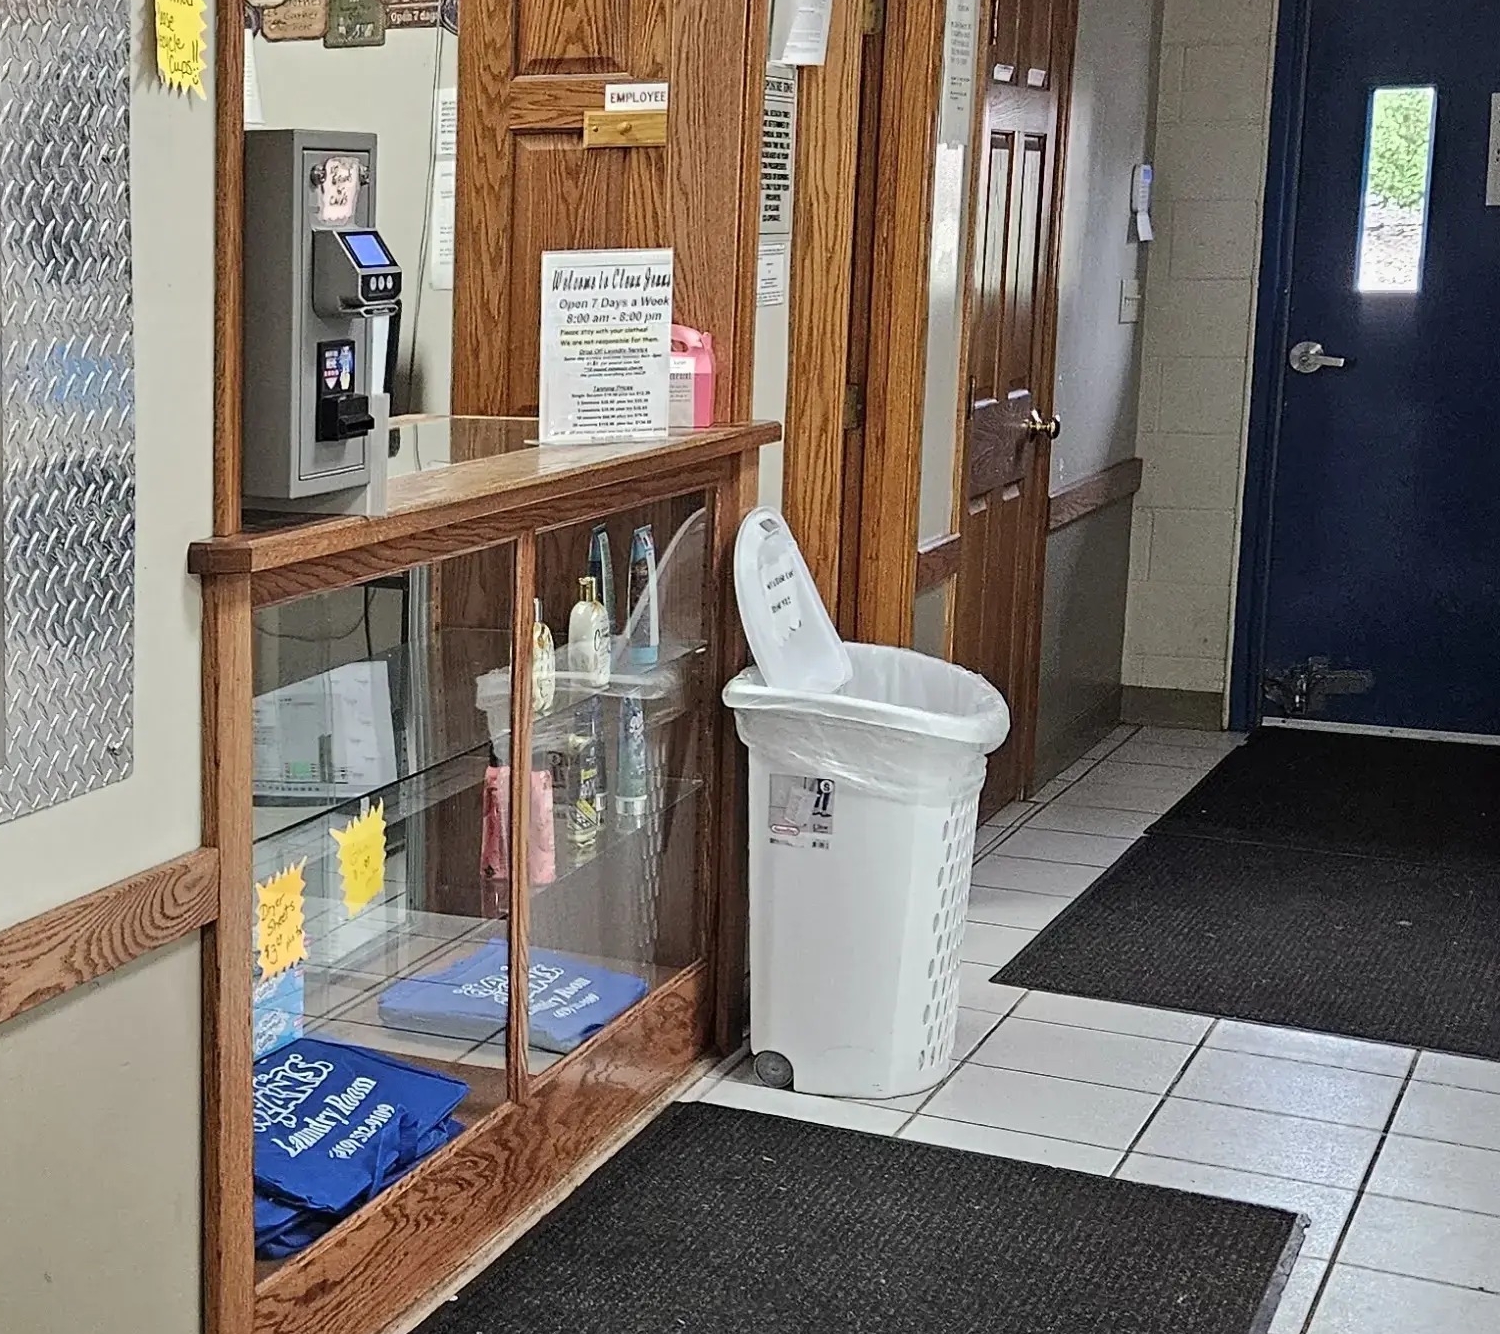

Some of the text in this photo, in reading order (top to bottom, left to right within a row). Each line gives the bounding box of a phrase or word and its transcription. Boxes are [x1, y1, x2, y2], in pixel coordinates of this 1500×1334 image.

[610, 91, 666, 104] EMPLOYEE
[552, 269, 596, 291] Welcome
[559, 295, 670, 311] Open 7 Days a Week
[566, 313, 590, 324] 8:00
[592, 314, 610, 323] am
[619, 312, 642, 322] 8:00
[644, 312, 662, 324] pm
[560, 328, 580, 336] Please
[595, 327, 609, 335] with
[610, 327, 623, 336] your
[595, 338, 629, 346] responsible
[630, 336, 641, 344] for
[259, 893, 285, 922] Dryer
[267, 902, 296, 937] Sheets
[271, 1076, 377, 1158] Laundry Room
